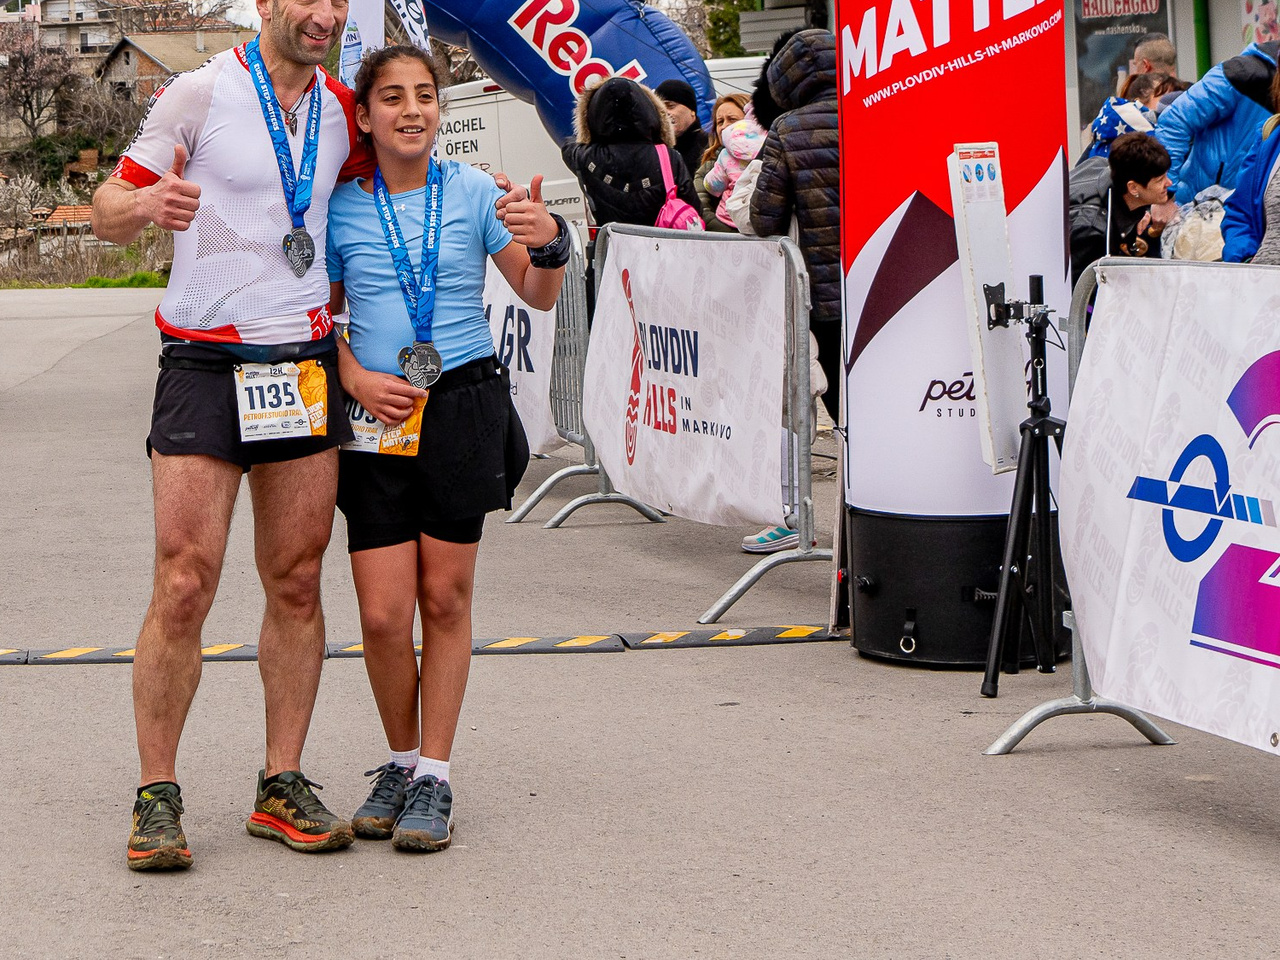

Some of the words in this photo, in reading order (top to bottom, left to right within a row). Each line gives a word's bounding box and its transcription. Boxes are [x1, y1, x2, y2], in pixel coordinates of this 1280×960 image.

[862, 9, 1062, 109] WWW.PLOVDIV-HILLS-IN-MARKOVO.COM
[437, 117, 486, 136] KACHEL
[445, 139, 479, 156] ÖFEN
[244, 381, 296, 411] 1135
[681, 396, 692, 411] IN
[936, 408, 976, 418] STUD
